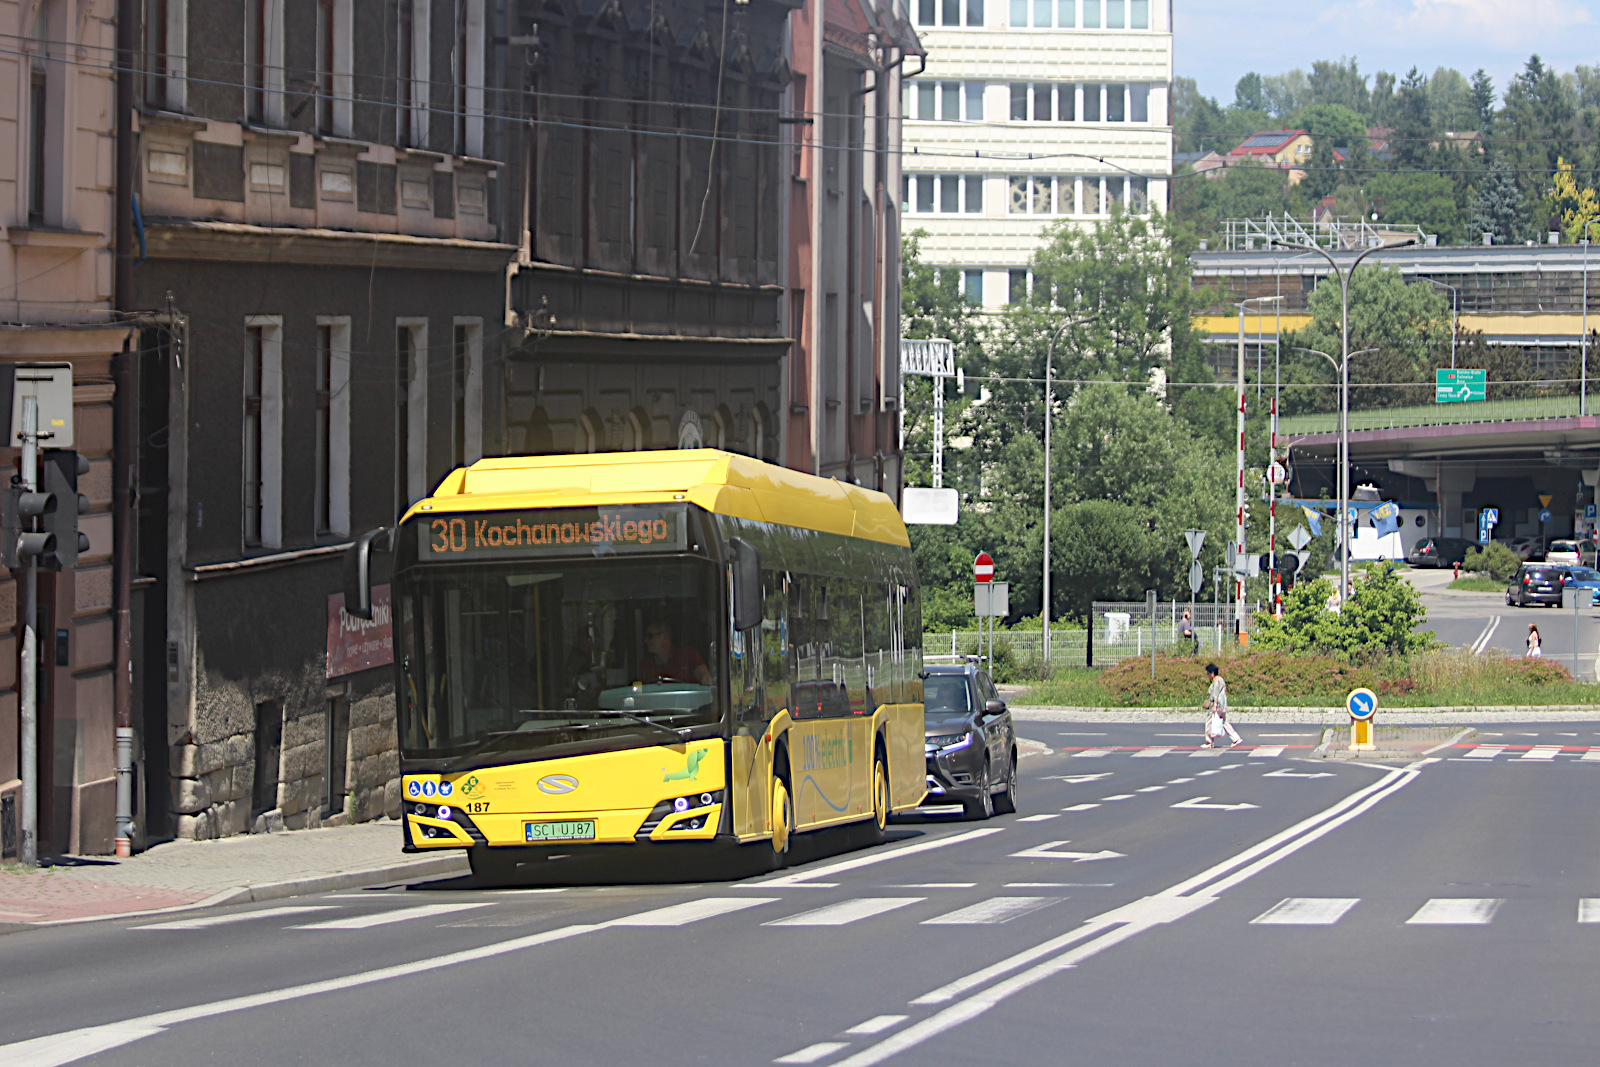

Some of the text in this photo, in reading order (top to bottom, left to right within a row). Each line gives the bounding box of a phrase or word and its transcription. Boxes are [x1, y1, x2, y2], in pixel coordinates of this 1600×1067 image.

[1587, 505, 1595, 516] P
[431, 514, 668, 553] 30 Kochanowskiego
[1480, 529, 1487, 542] P
[466, 802, 491, 813] 187
